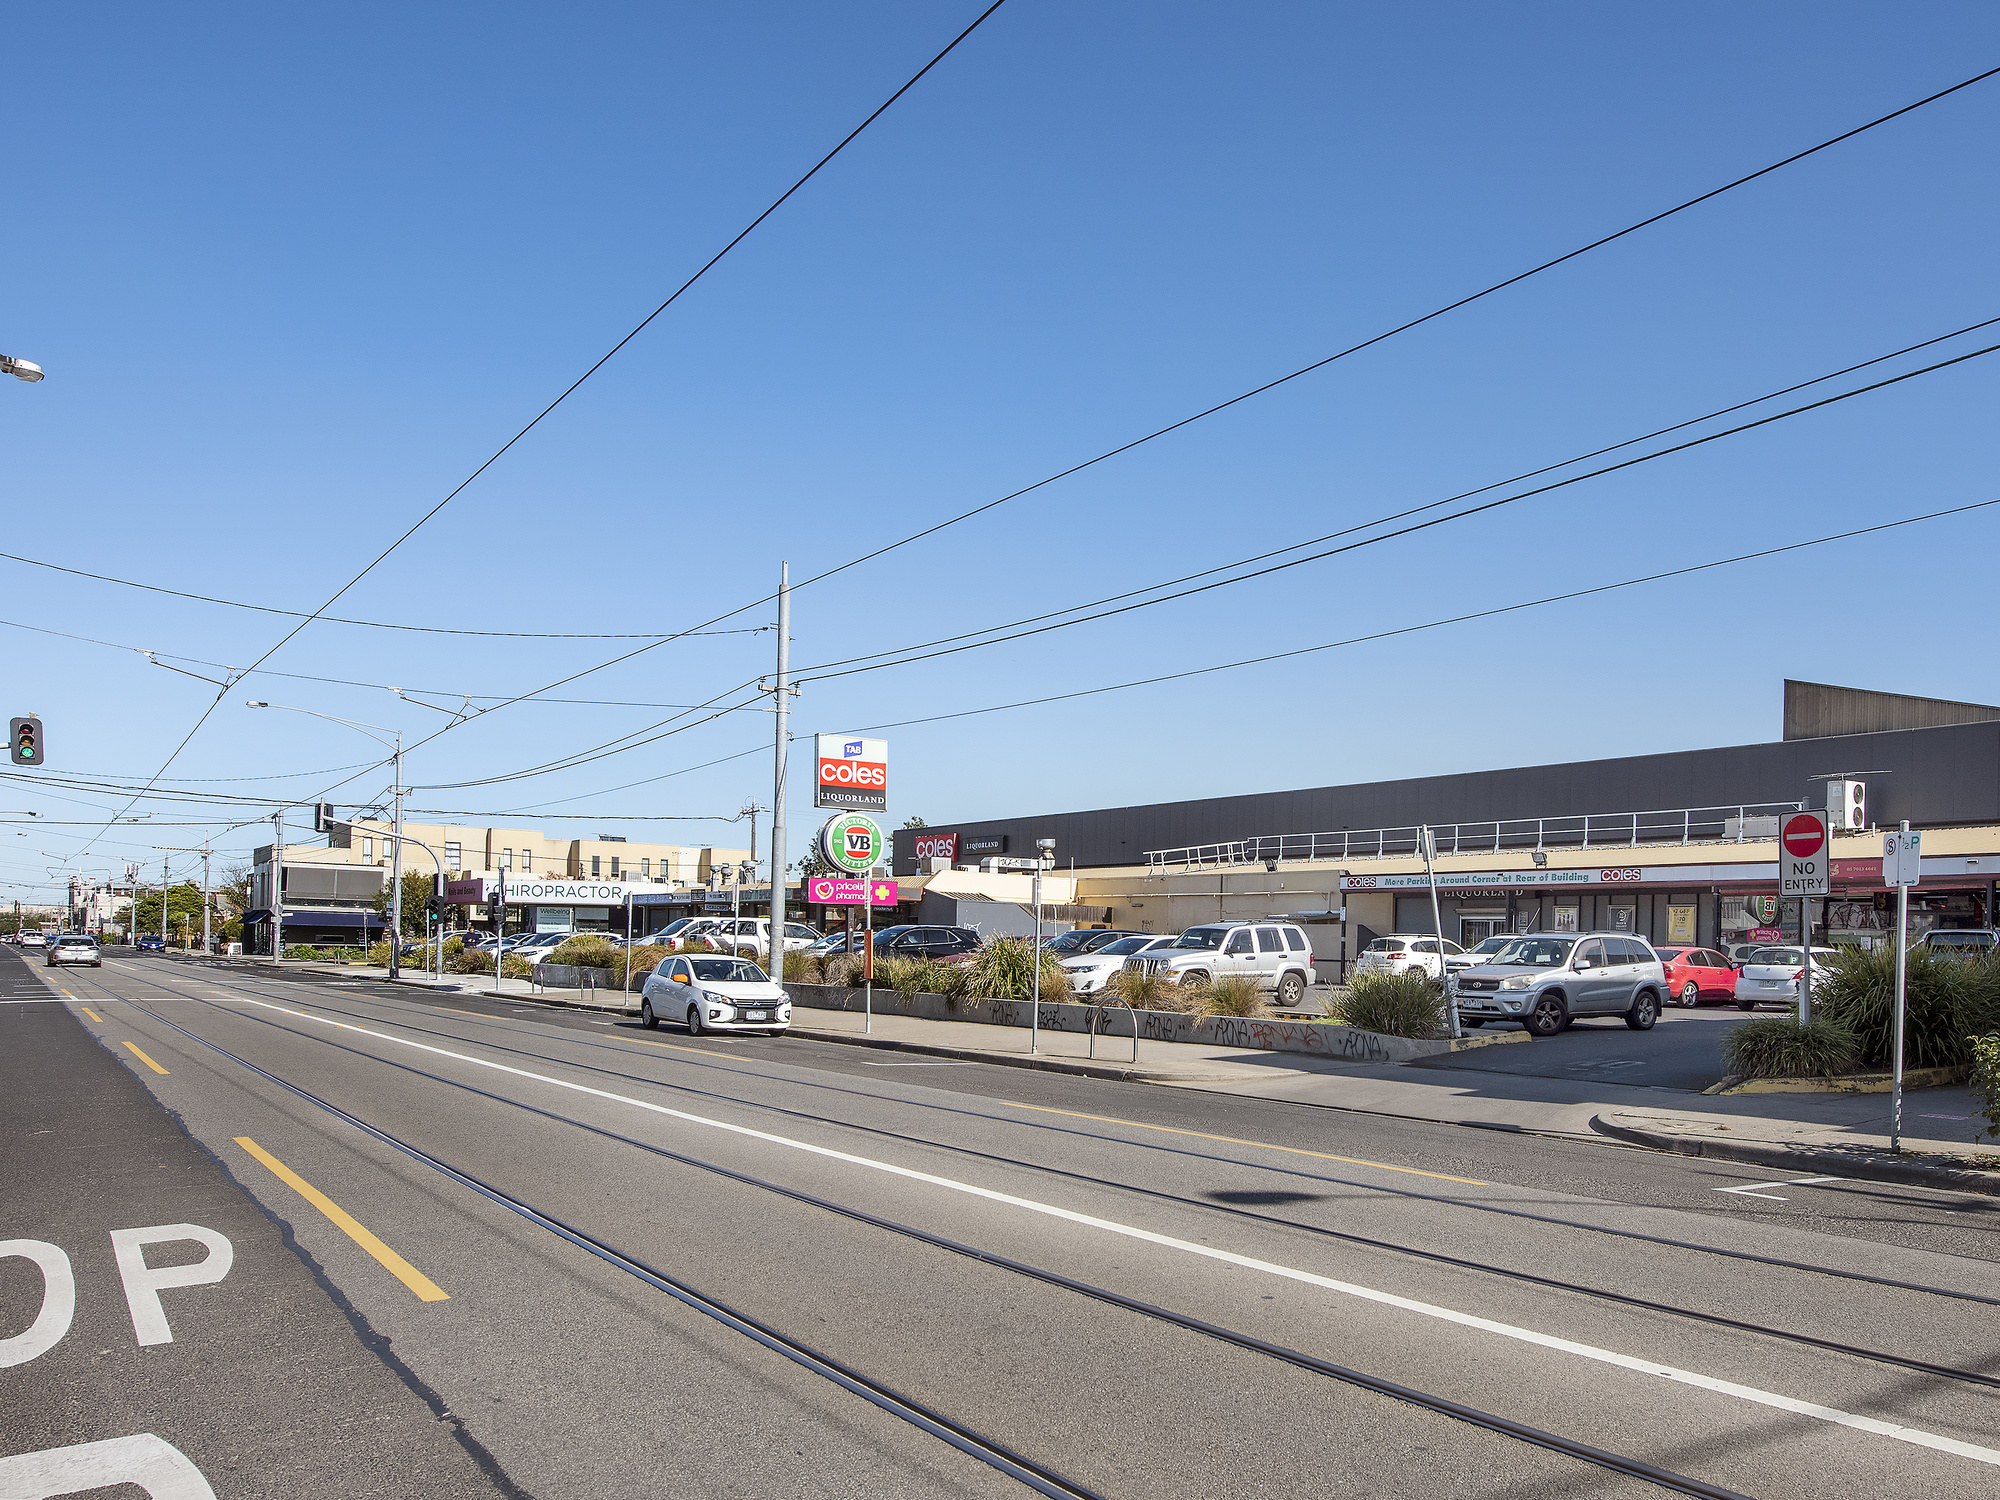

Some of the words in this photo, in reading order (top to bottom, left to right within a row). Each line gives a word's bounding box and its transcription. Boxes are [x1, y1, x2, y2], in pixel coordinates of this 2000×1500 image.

[845, 744, 862, 754] TAB
[820, 761, 885, 786] coles
[820, 792, 885, 804] LIQUORLAND
[838, 817, 876, 833] VICTORIA
[846, 834, 871, 850] VB
[916, 839, 954, 858] coles
[1793, 862, 1815, 875] NO
[1385, 878, 1404, 886] More
[1440, 875, 1470, 884] Around
[1472, 875, 1500, 883] Corner
[1503, 875, 1512, 883] at
[1515, 874, 1537, 882] Rear
[1539, 873, 1549, 882] of
[1552, 873, 1589, 883] Building
[1601, 869, 1641, 881] coles
[836, 882, 873, 892] pricelin
[1347, 877, 1377, 888] coles
[1785, 878, 1824, 890] ENTRY
[836, 892, 873, 902] pharmay
[1444, 889, 1524, 898] LIQUORLAD
[540, 907, 570, 916] Wellbeing
